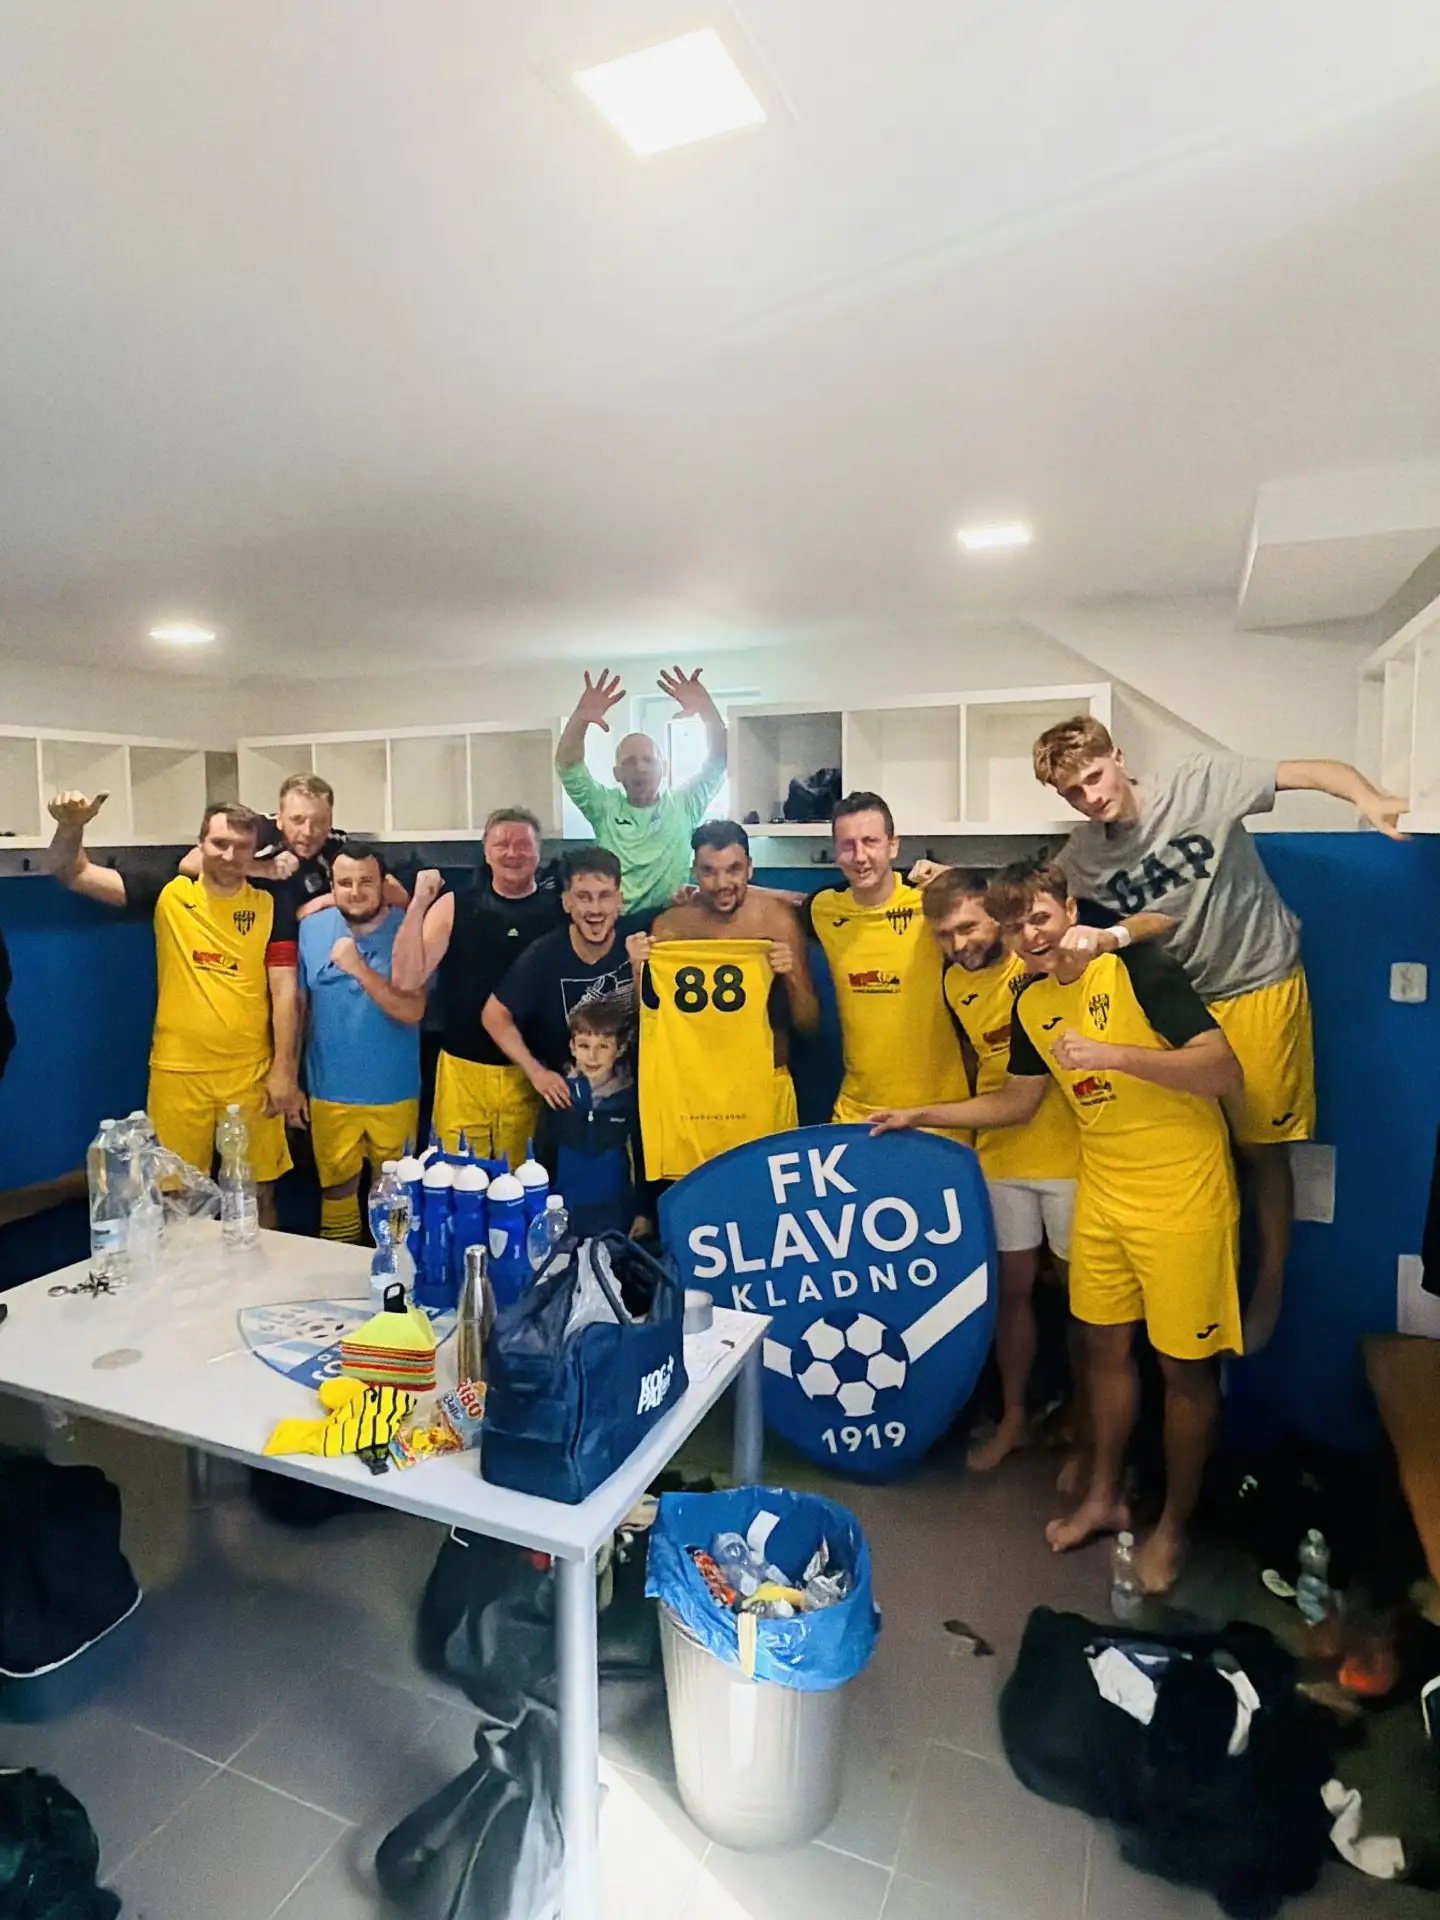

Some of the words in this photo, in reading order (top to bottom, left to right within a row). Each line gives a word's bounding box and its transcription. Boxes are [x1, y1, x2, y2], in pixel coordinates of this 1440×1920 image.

[1106, 834, 1215, 914] GAP
[674, 964, 746, 1014] 88
[767, 1143, 858, 1204] FK
[688, 1188, 962, 1279] SLAVOJ
[731, 1257, 937, 1312] KLADNO
[821, 1421, 906, 1455] 1919
